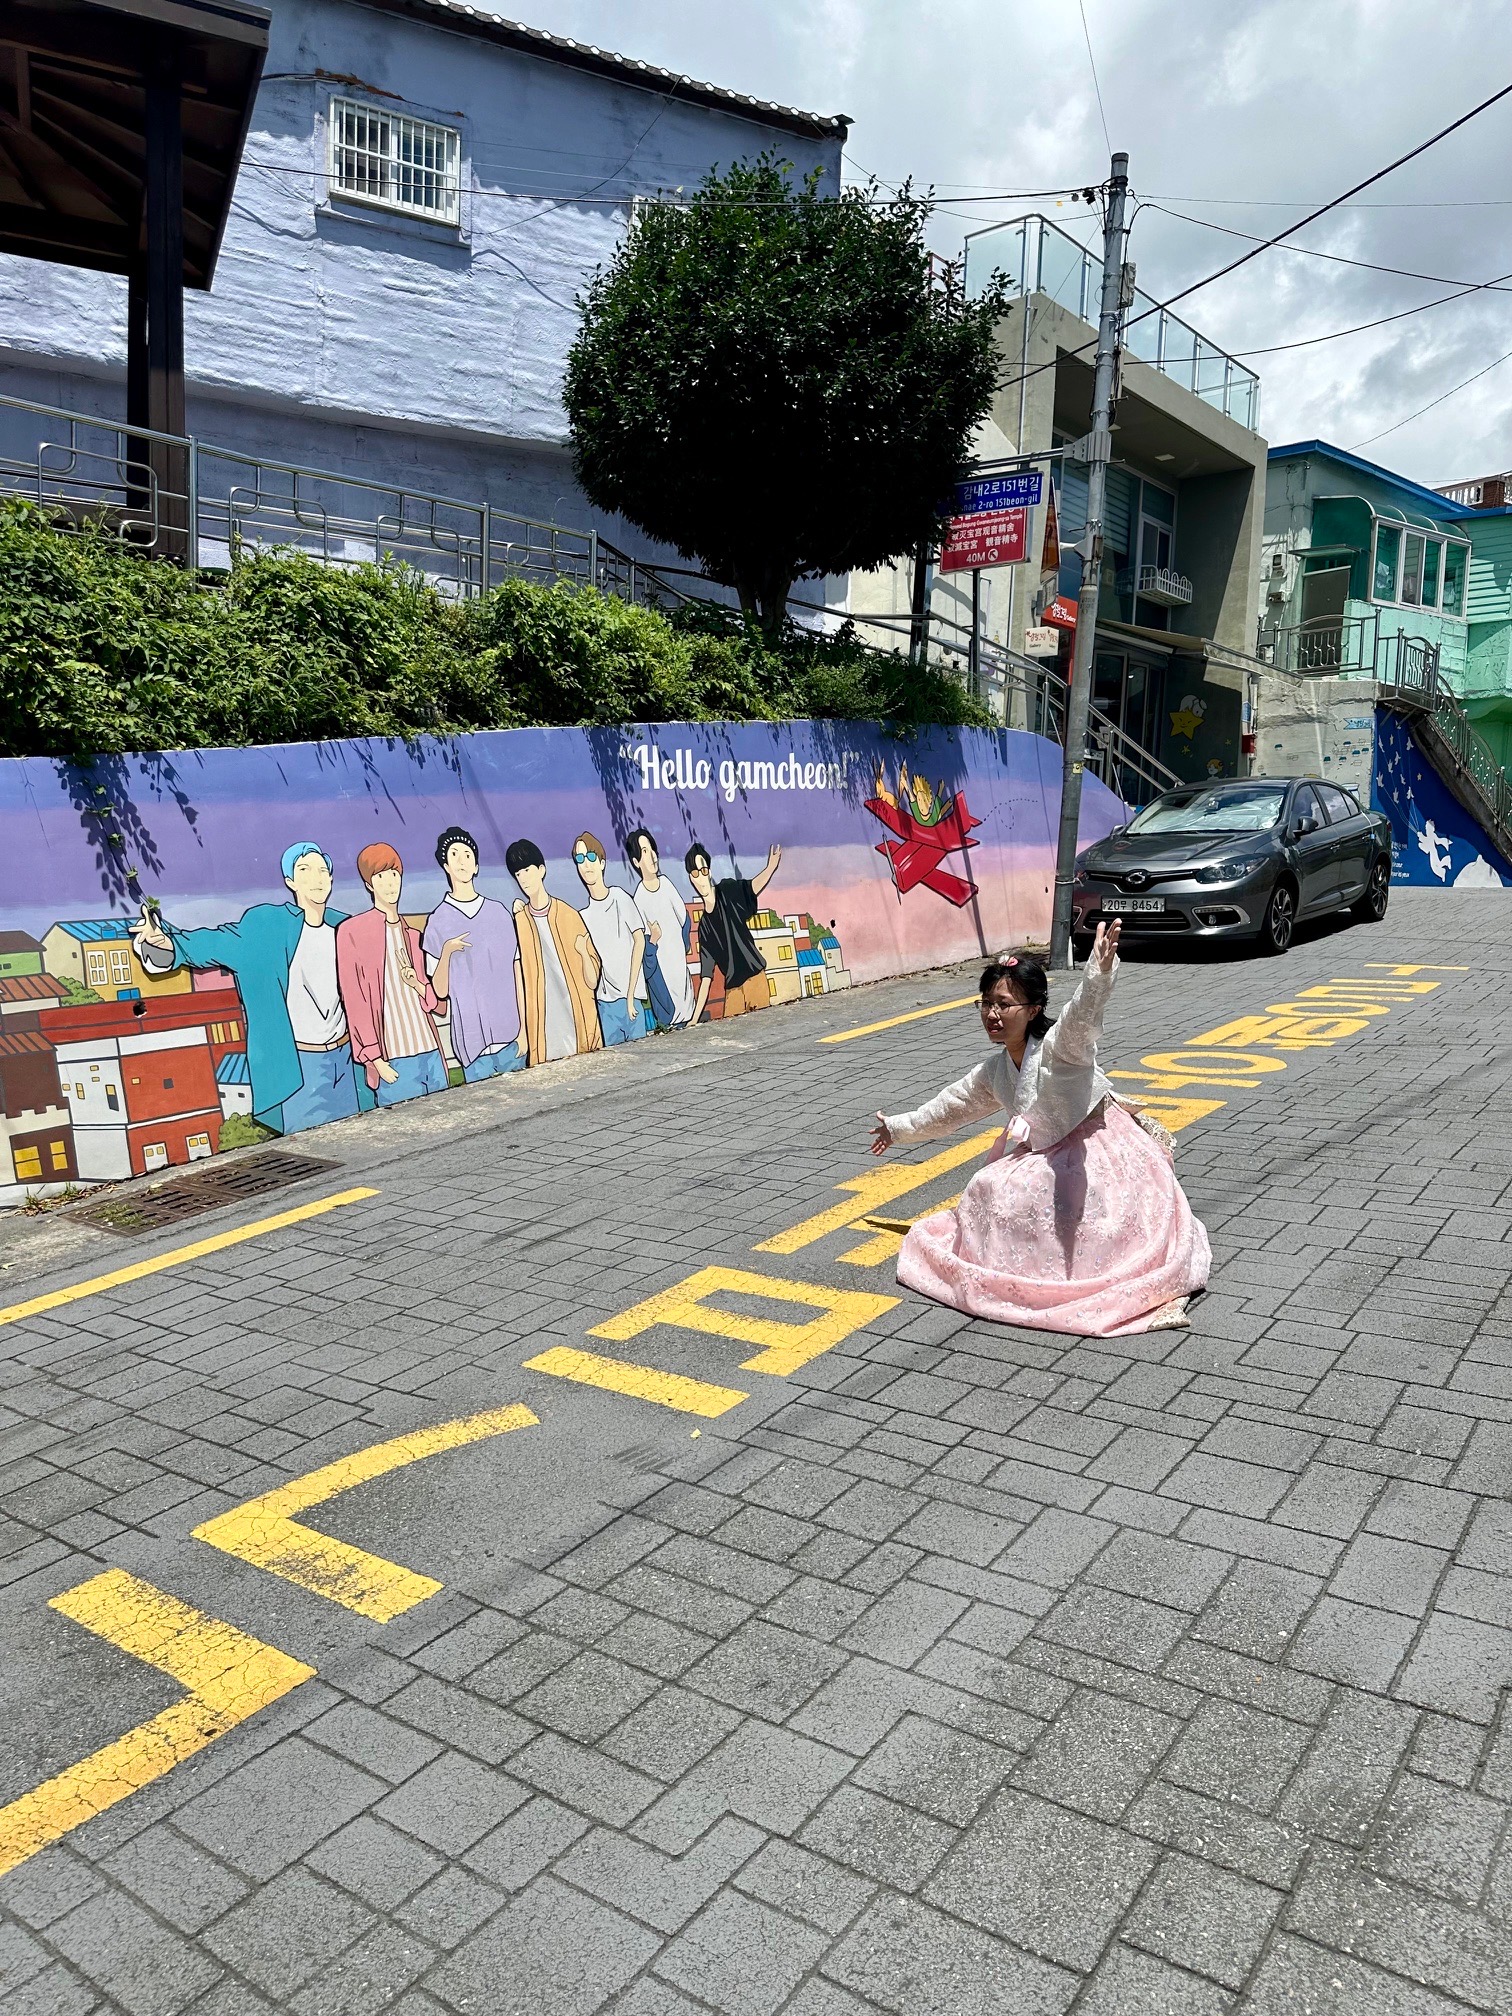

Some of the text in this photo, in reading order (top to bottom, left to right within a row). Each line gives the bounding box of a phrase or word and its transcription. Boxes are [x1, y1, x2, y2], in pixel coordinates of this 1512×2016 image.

[963, 476, 1040, 501] 감내2로151번길
[978, 500, 994, 510] 2-ro
[995, 493, 1038, 508] 151beon-gil
[966, 551, 986, 563] 40M
[1107, 899, 1160, 911] 20무 8454
